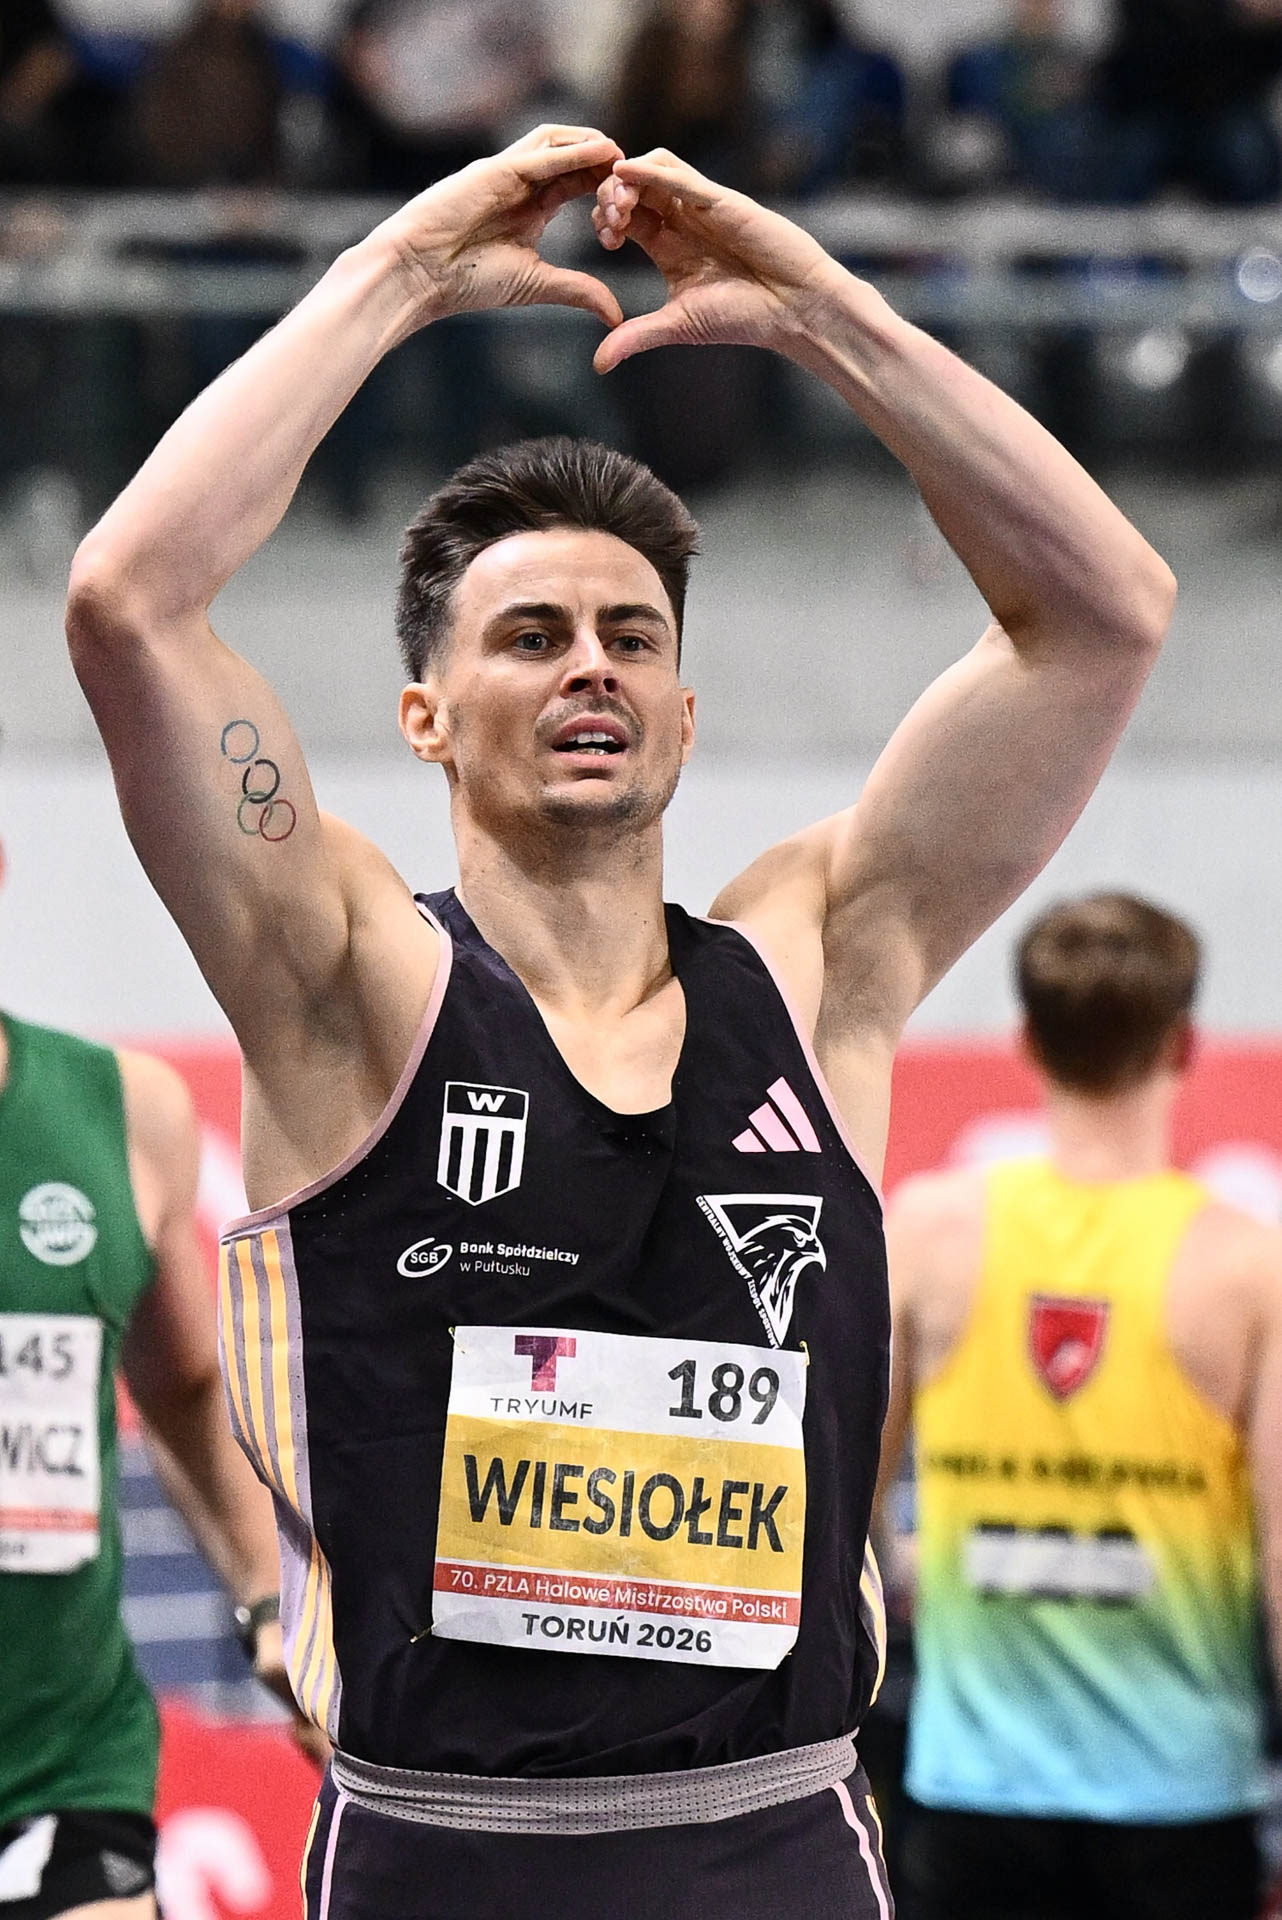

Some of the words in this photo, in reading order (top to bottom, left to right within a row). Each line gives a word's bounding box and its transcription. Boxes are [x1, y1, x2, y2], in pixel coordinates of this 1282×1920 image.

[467, 1091, 506, 1113] W
[695, 1195, 727, 1239] CENTRALNY
[410, 1251, 439, 1264] SGB
[460, 1241, 494, 1255] Bank
[497, 1243, 580, 1265] Spółdzielczy
[460, 1261, 471, 1272] w
[475, 1260, 531, 1277] Pułtusku
[667, 1358, 780, 1425] 189
[489, 1397, 594, 1420] TRYUMF
[463, 1454, 789, 1553] WIESIOŁEK
[450, 1570, 478, 1590] 70.
[484, 1575, 530, 1595] PZLA
[536, 1580, 611, 1602] Halowe
[615, 1588, 727, 1614] Mistrzostwa
[733, 1599, 788, 1619] Polski
[521, 1612, 630, 1645] TORUŃ
[636, 1623, 713, 1653] 2026
